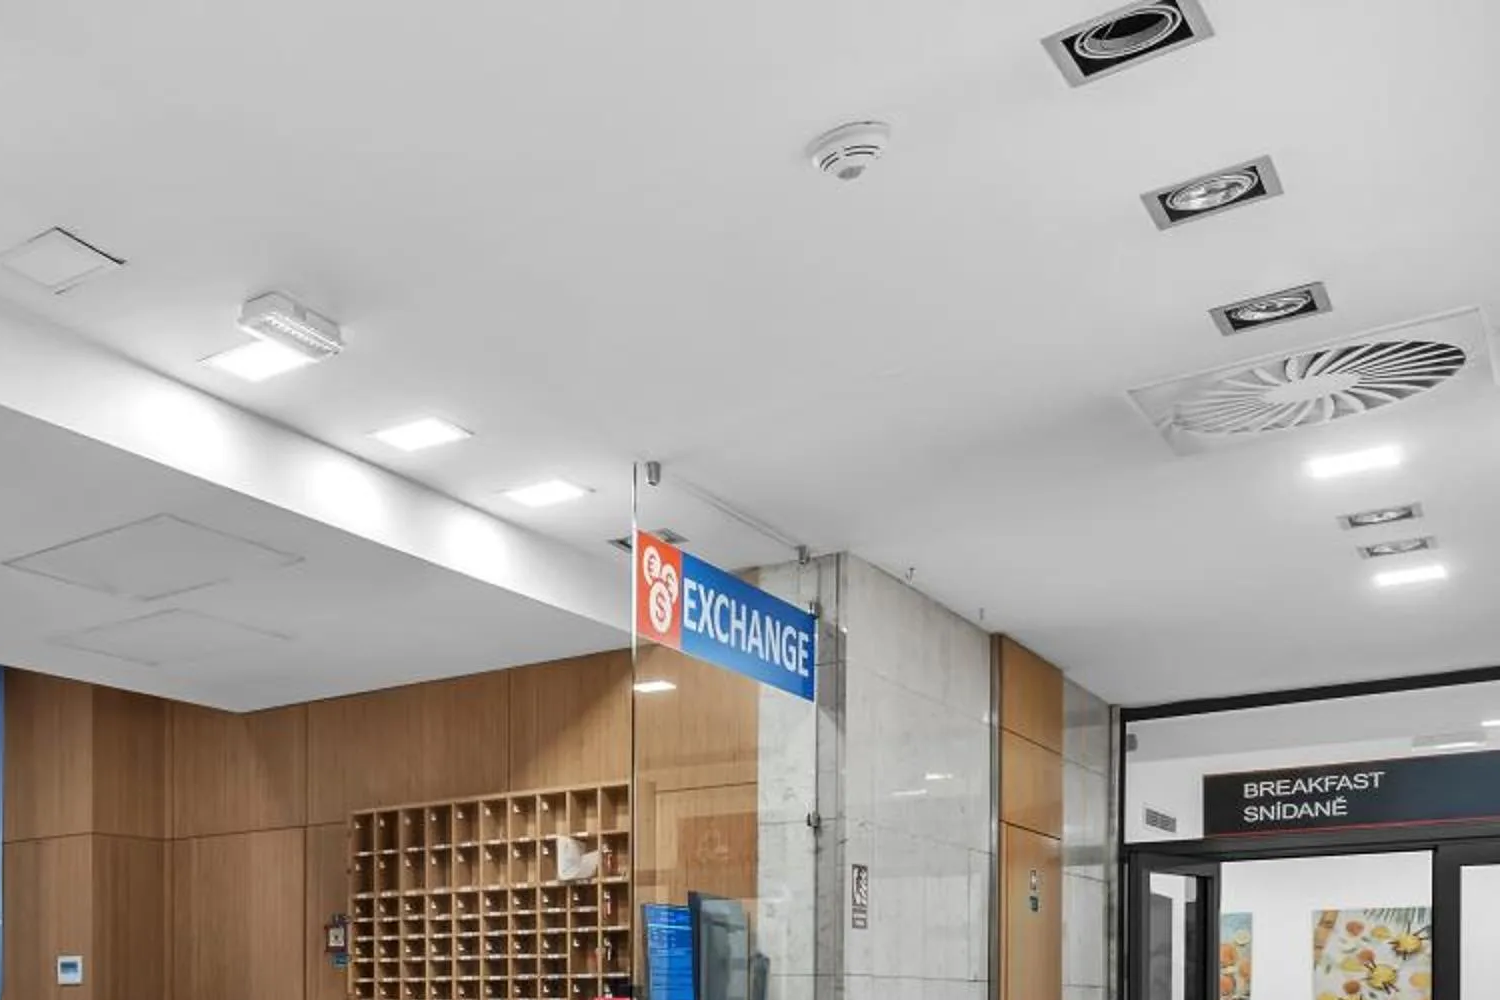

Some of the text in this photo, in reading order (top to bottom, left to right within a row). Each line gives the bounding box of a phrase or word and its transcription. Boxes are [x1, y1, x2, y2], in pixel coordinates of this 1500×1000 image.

[683, 577, 809, 677] EXCHANGE
[1243, 772, 1385, 798] BREAKFAST
[1243, 796, 1348, 822] SNÍDANĚ
